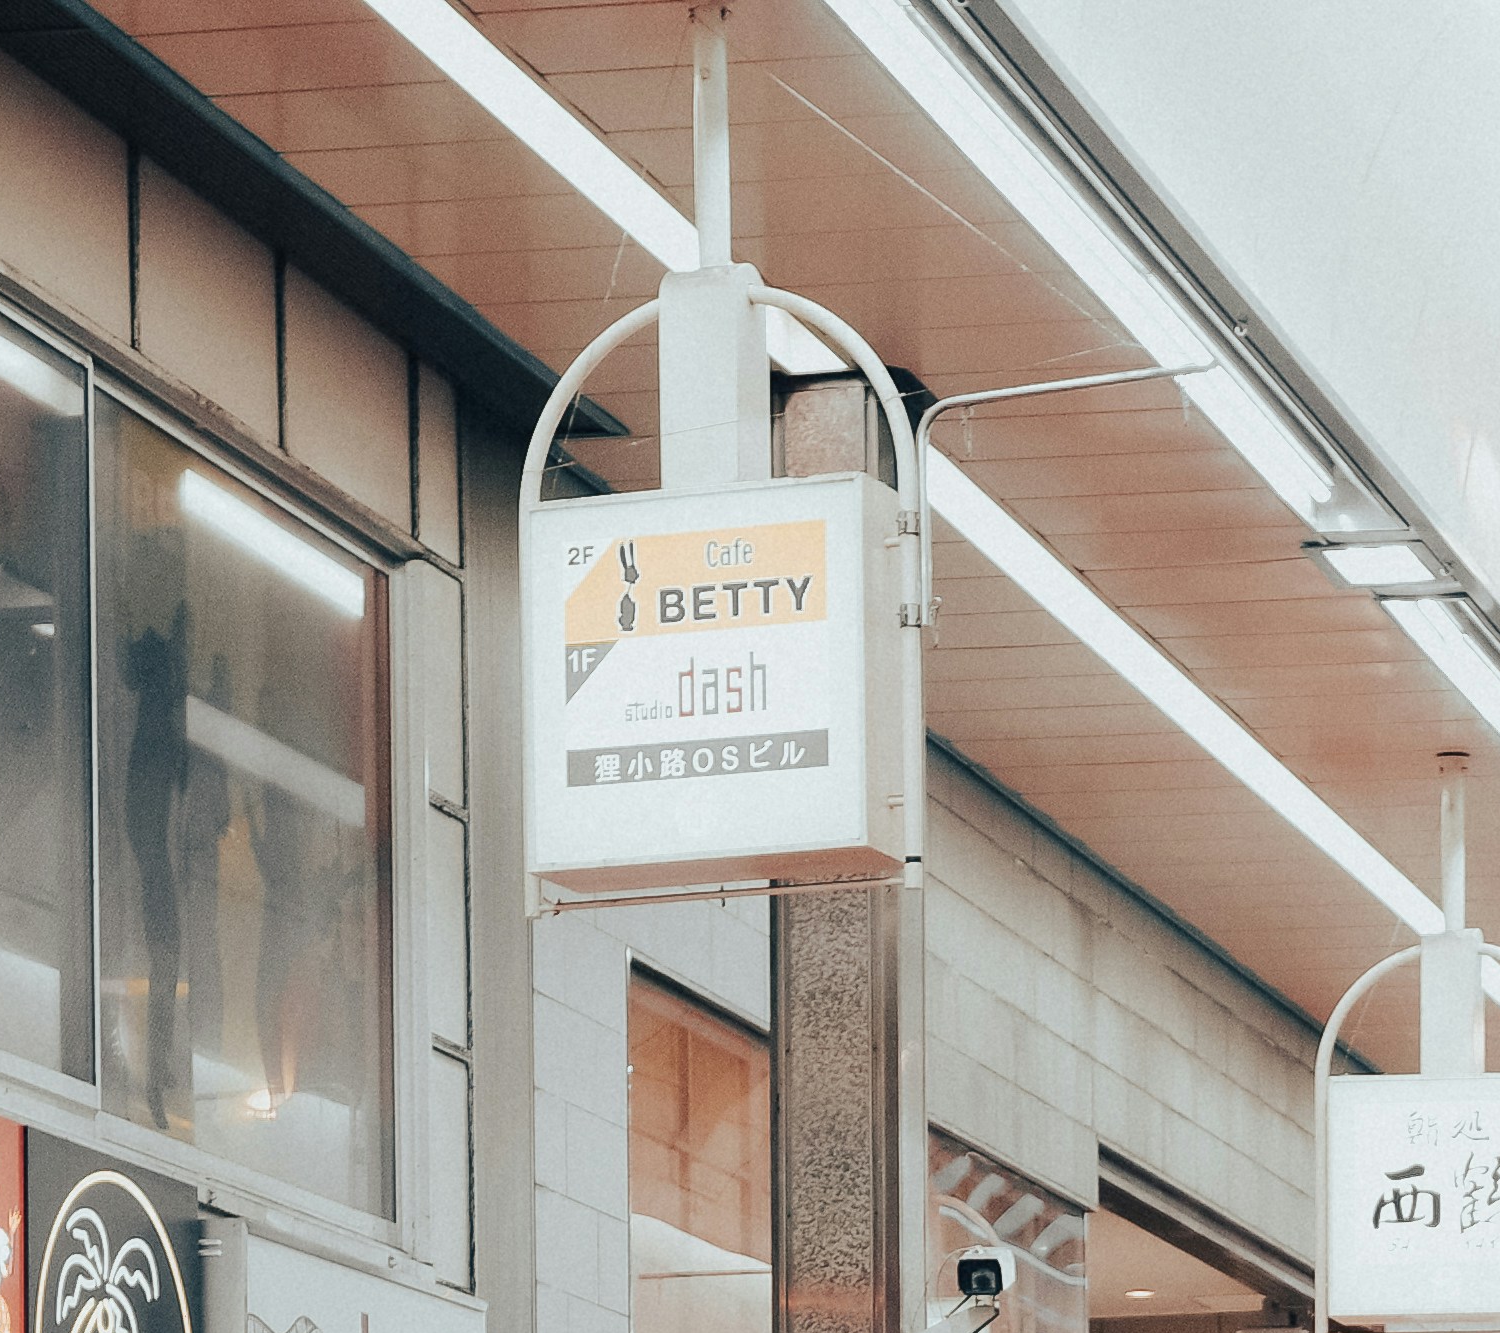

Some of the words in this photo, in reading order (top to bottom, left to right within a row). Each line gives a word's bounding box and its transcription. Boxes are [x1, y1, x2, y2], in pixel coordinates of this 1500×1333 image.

[568, 545, 594, 566] 2F
[705, 537, 754, 568] Cafe
[659, 574, 812, 624] BETTY
[568, 647, 598, 674] 1F
[624, 702, 673, 722] studio
[678, 651, 767, 718] dash
[594, 740, 806, 784] 狸小路OSビル
